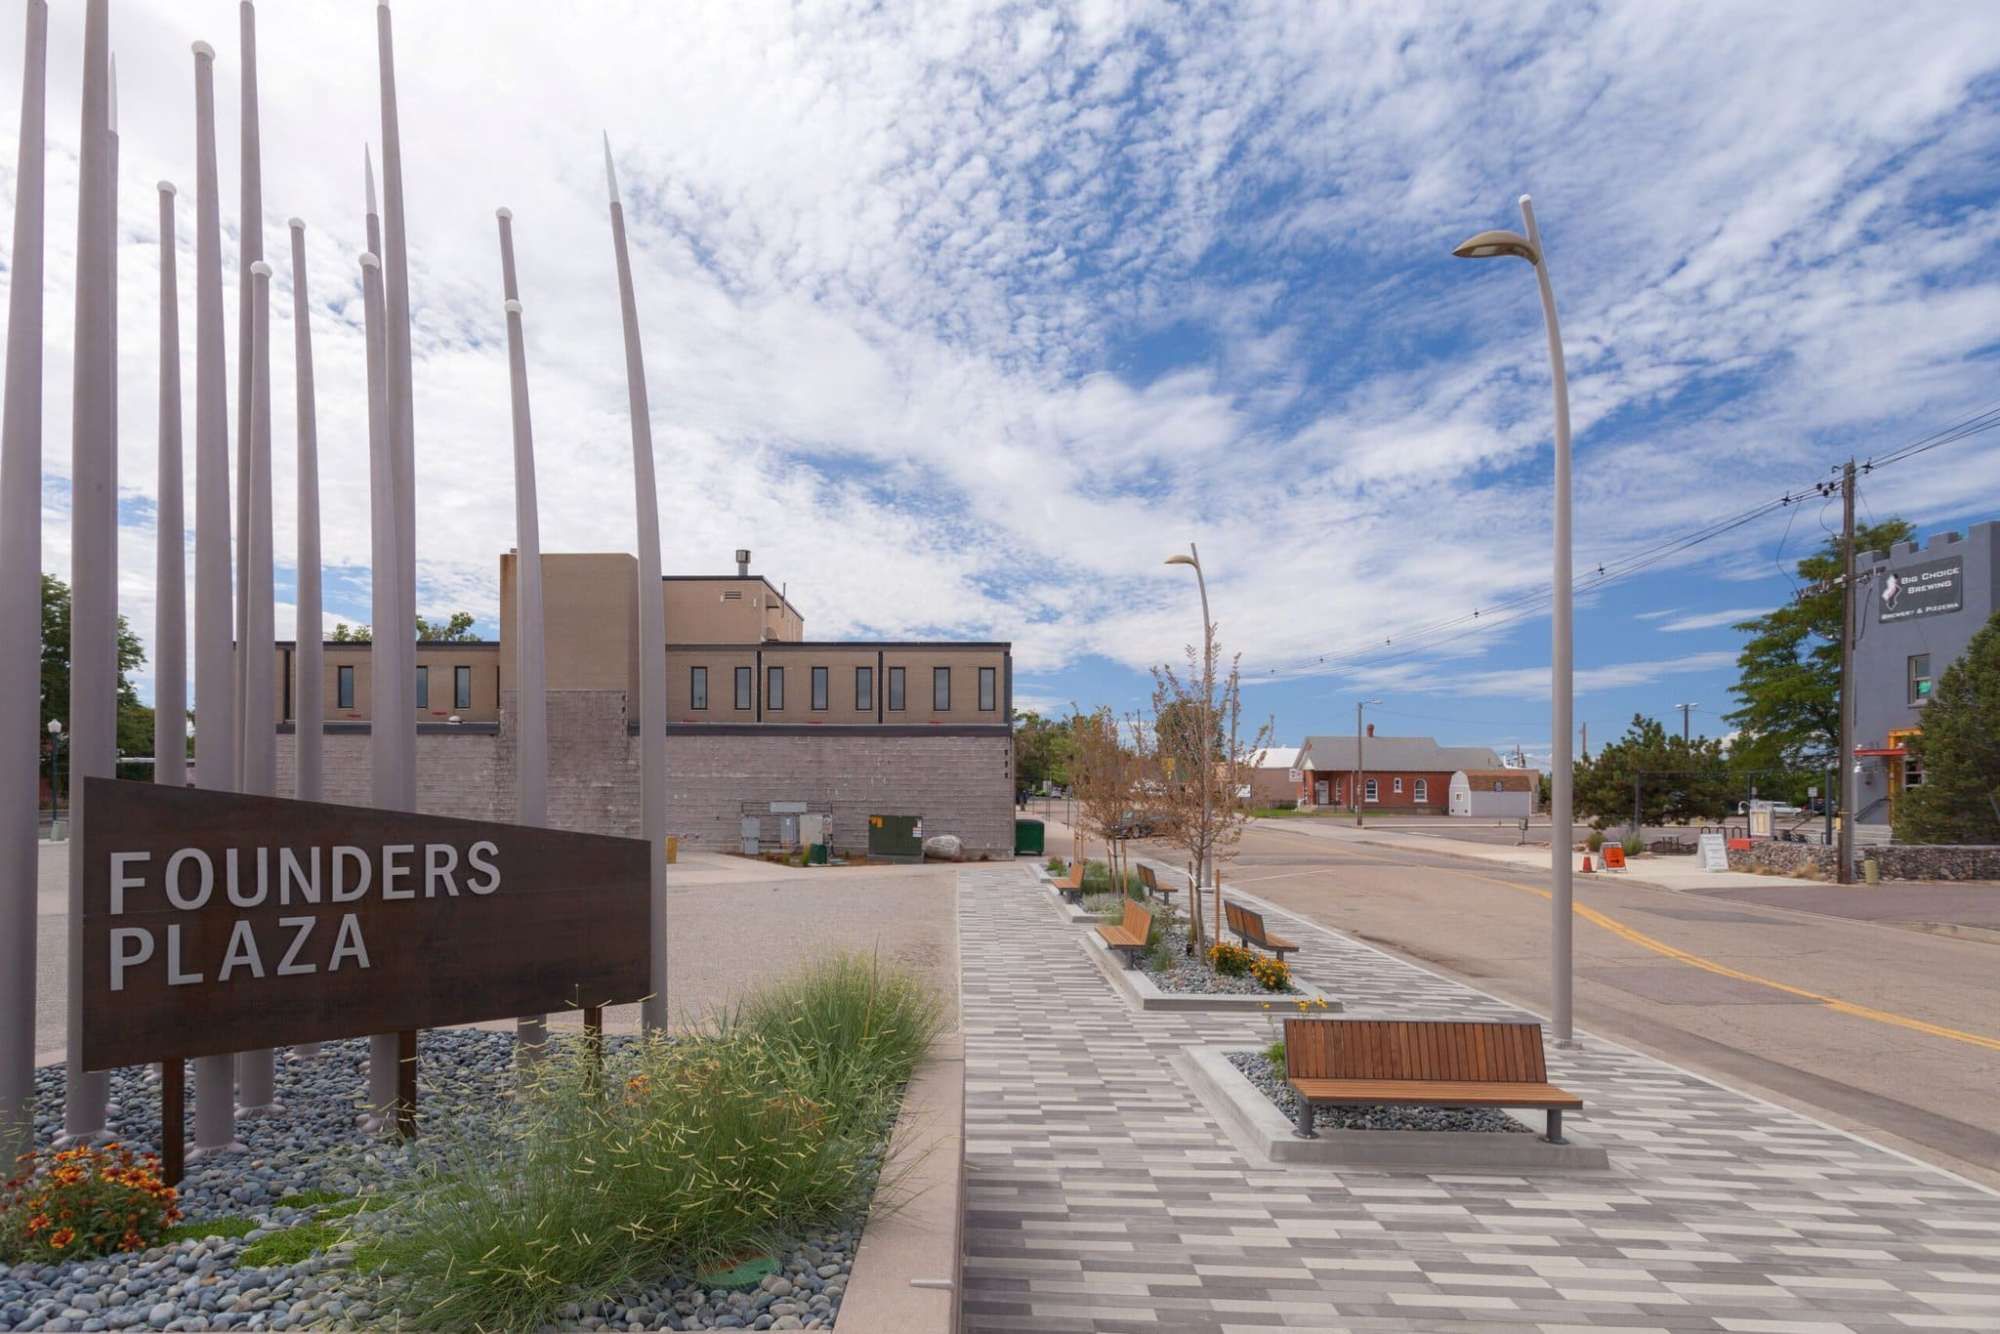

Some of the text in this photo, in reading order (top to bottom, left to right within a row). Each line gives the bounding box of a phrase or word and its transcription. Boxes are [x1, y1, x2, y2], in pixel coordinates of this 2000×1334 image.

[1901, 567, 1959, 584] BIG CHOICE
[1907, 580, 1952, 594] BREWING
[109, 840, 501, 915] FOUNDERS
[109, 913, 371, 991] PLAZA
